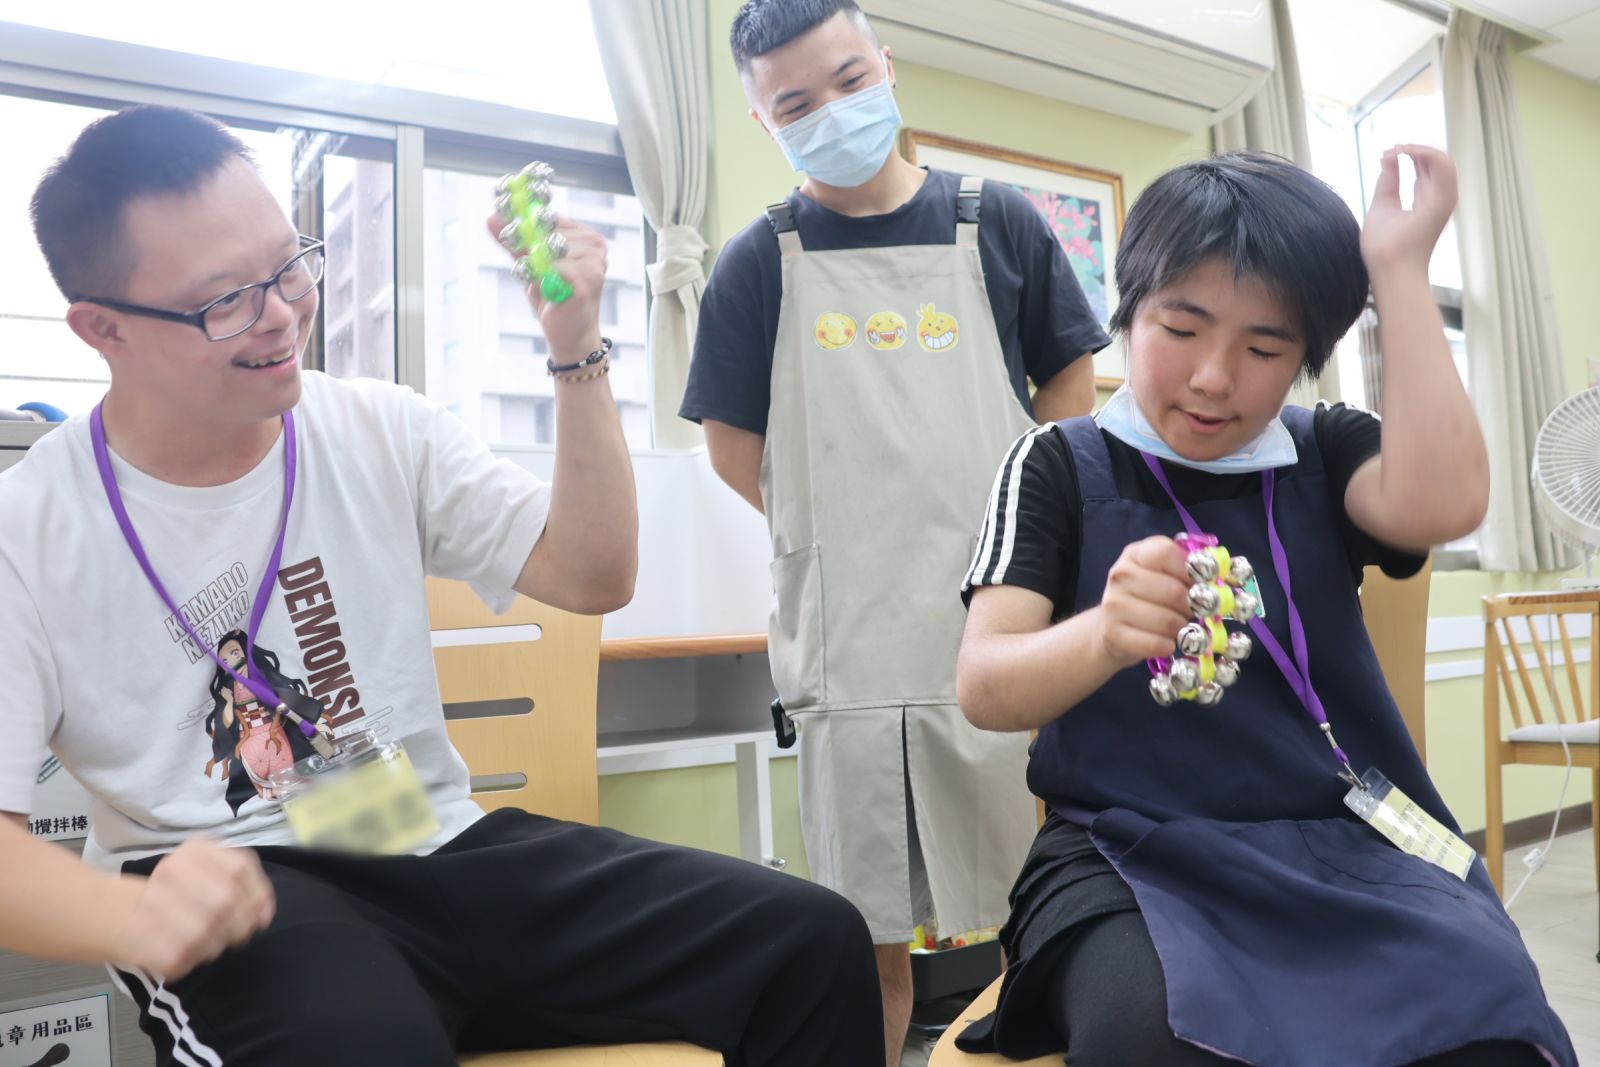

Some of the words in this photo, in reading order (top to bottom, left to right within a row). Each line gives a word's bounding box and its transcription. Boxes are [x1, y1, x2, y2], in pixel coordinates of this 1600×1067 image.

[164, 561, 249, 643] KAMADO
[181, 590, 250, 664] NEZUKO
[0, 1014, 94, 1047] 章用品區
